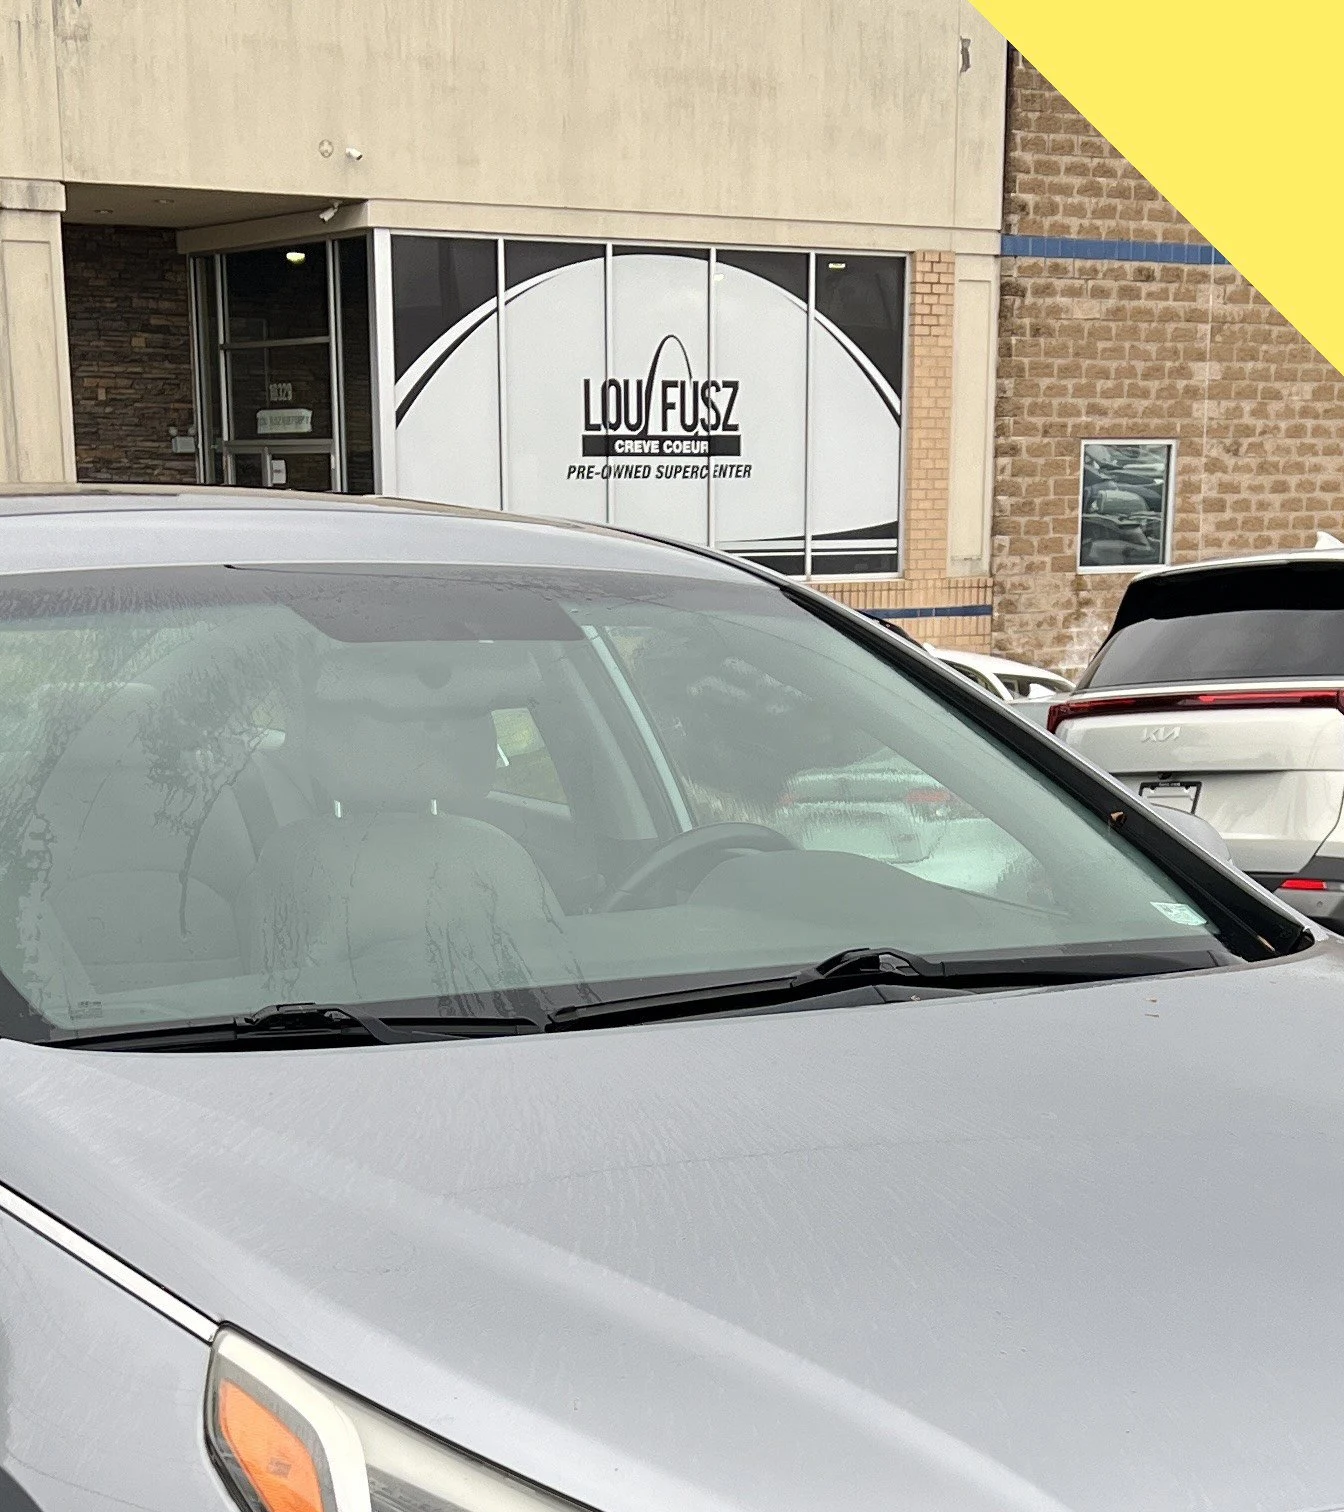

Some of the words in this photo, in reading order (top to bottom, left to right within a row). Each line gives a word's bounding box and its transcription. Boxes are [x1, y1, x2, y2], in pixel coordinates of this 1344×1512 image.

[583, 378, 644, 432] LOU
[661, 379, 740, 432] FUSZ
[614, 440, 660, 454] CREVE
[663, 440, 709, 454] COEUR
[567, 464, 652, 480] PRE-OWNED
[655, 464, 753, 480] SUPERCENTER
